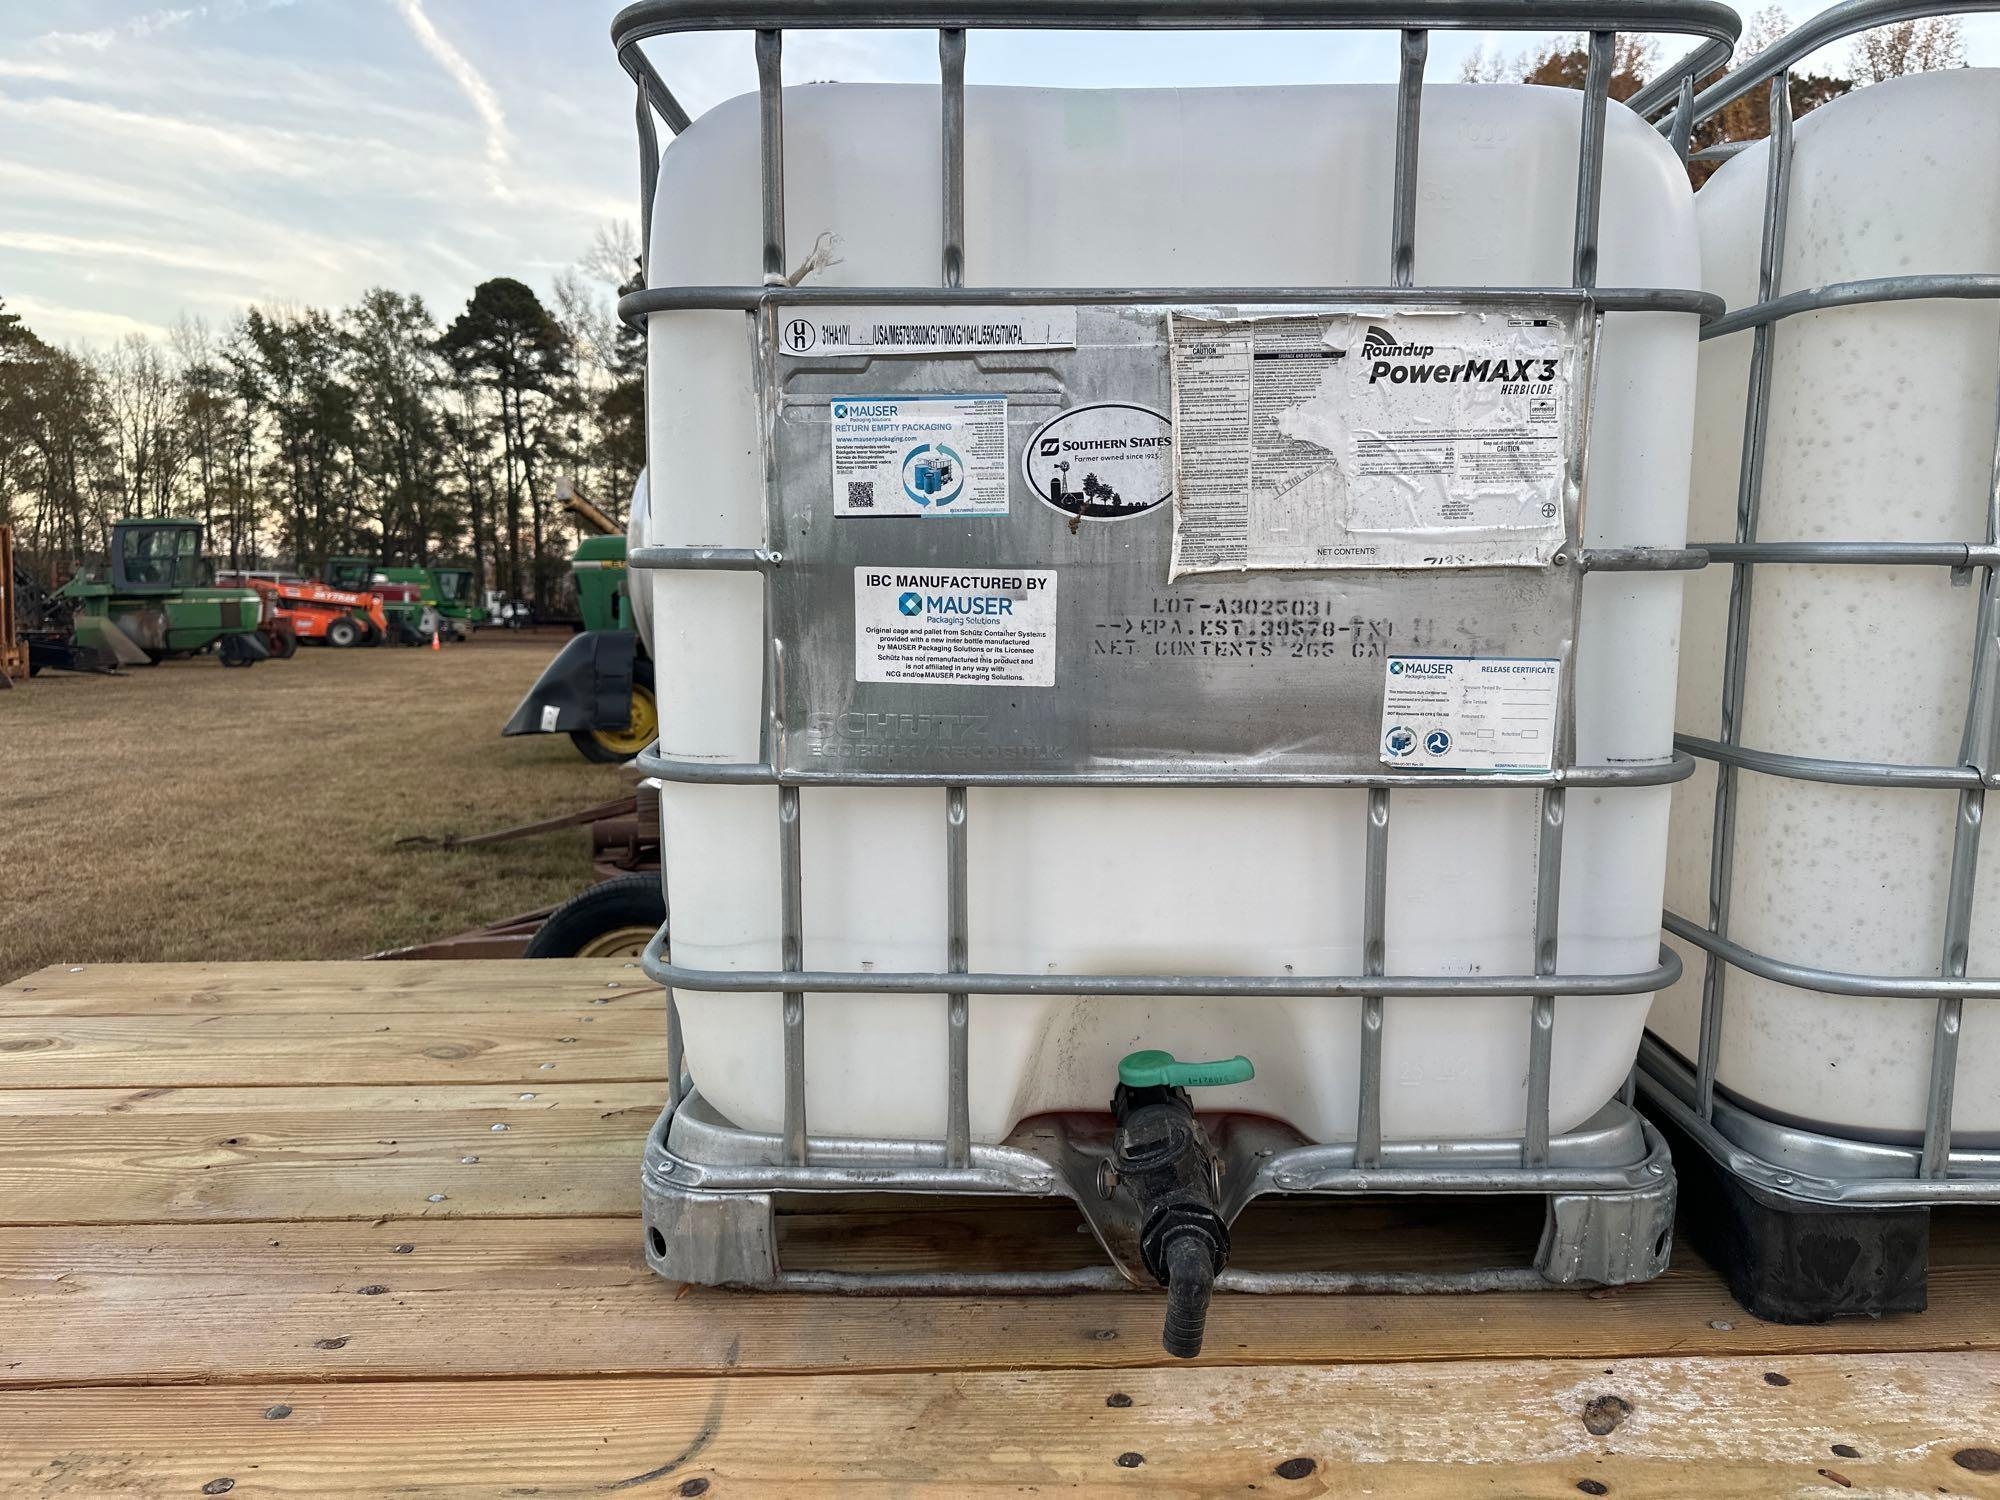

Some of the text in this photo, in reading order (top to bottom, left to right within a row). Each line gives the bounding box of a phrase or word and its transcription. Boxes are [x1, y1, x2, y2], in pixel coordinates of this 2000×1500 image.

[1193, 347, 1217, 355] CAUTION
[1361, 342, 1434, 360] Roundup
[1538, 359, 1558, 382] 3
[1500, 384, 1554, 395] HERBICIDE
[849, 405, 898, 417] MAUSER
[835, 423, 952, 432] RETURN EMPTY PACKAGING
[1062, 439, 1127, 451] SOUTHERN
[1129, 436, 1172, 448] STATES
[1100, 453, 1124, 461] owned
[866, 575, 1048, 590] IBC MANUFACTURED BY
[927, 596, 1013, 615] MAUSER
[927, 616, 1001, 626] Packaging Solutions
[984, 629, 1016, 637] Container
[917, 645, 952, 653] Packaging
[1095, 639, 1136, 655] NET
[1155, 640, 1272, 657] CONTENTS
[1290, 642, 1334, 657] 265
[1405, 664, 1454, 674] MAUSER
[1512, 666, 1555, 674] CERTIFICATE
[955, 672, 990, 681] Packaging
